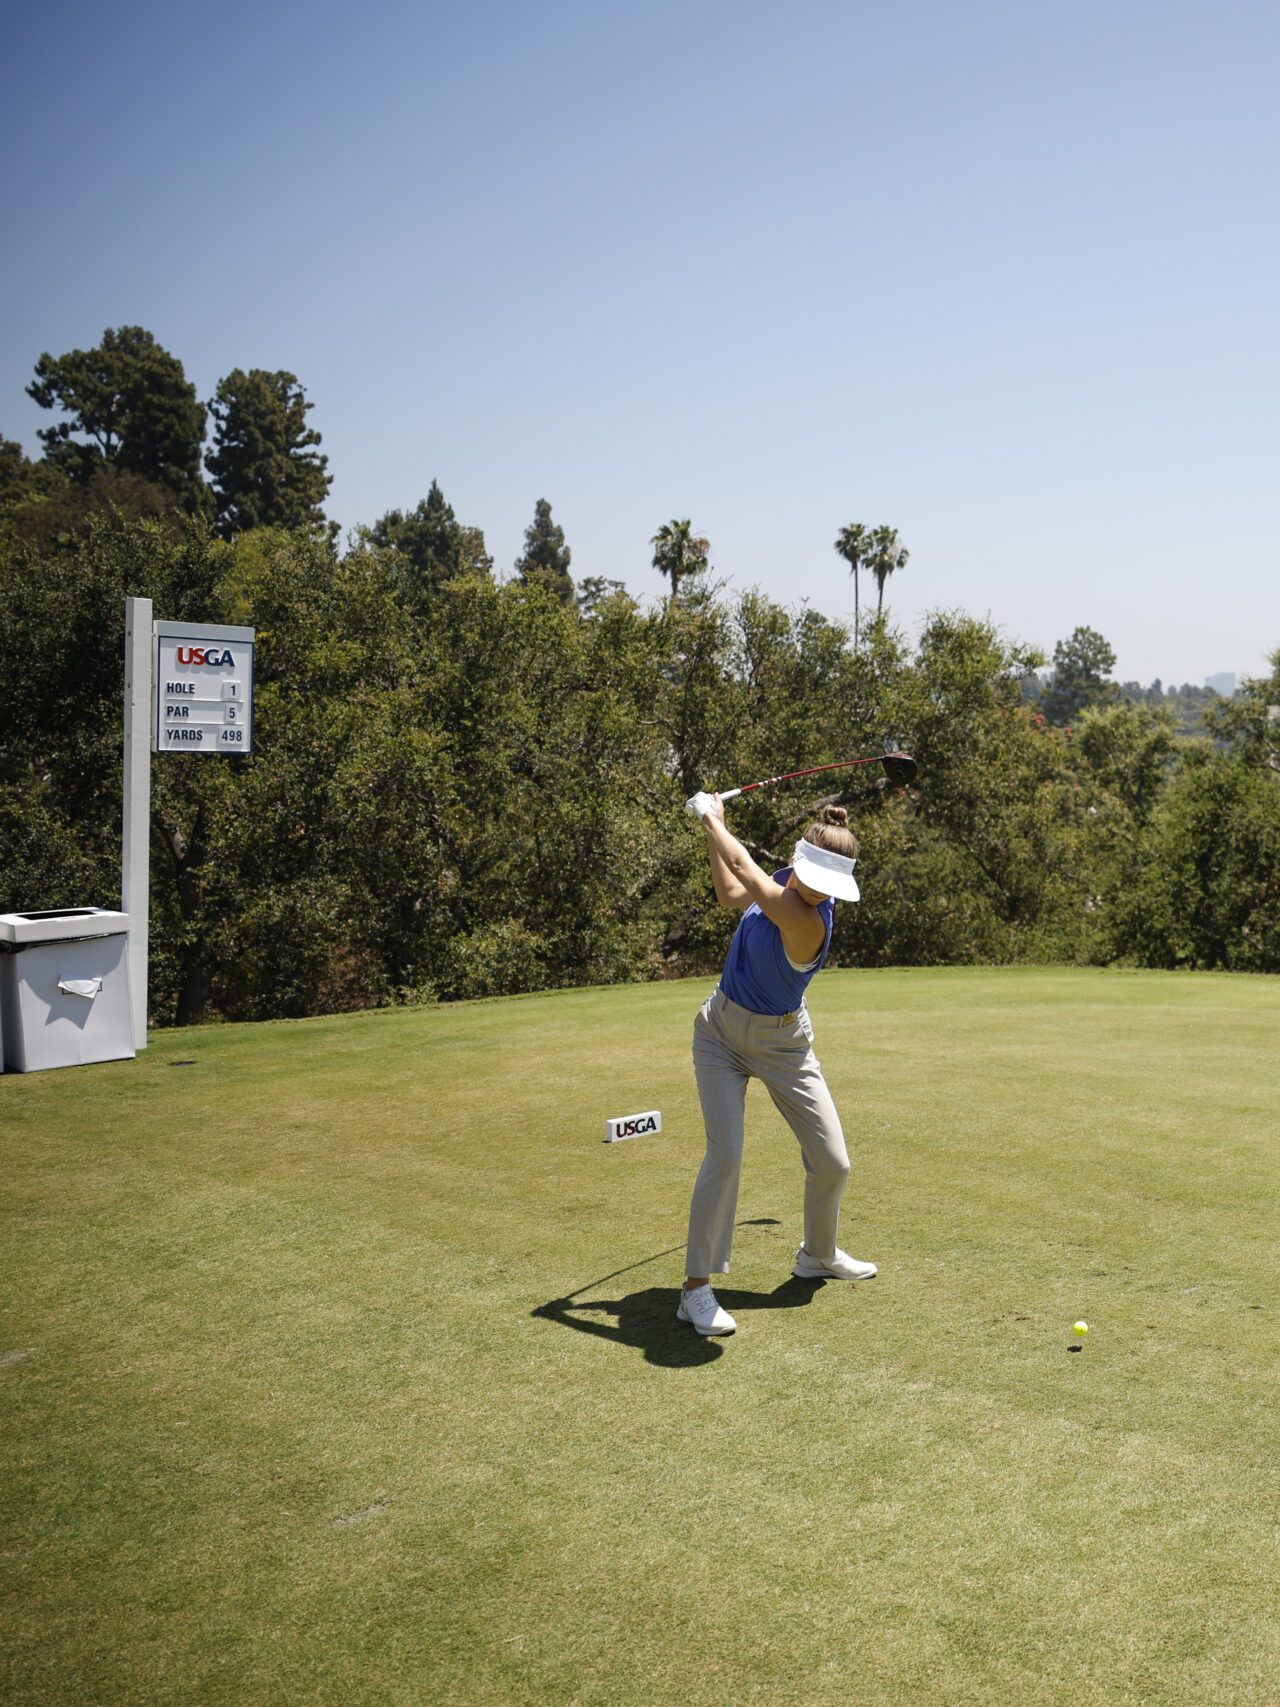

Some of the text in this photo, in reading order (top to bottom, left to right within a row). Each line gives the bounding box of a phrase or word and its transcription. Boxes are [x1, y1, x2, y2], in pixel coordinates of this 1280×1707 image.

[177, 646, 235, 667] USGA
[167, 682, 236, 696] HOLE 1
[167, 706, 236, 719] PAR 5
[167, 729, 242, 742] YARDS 498
[616, 1116, 657, 1138] USGA
